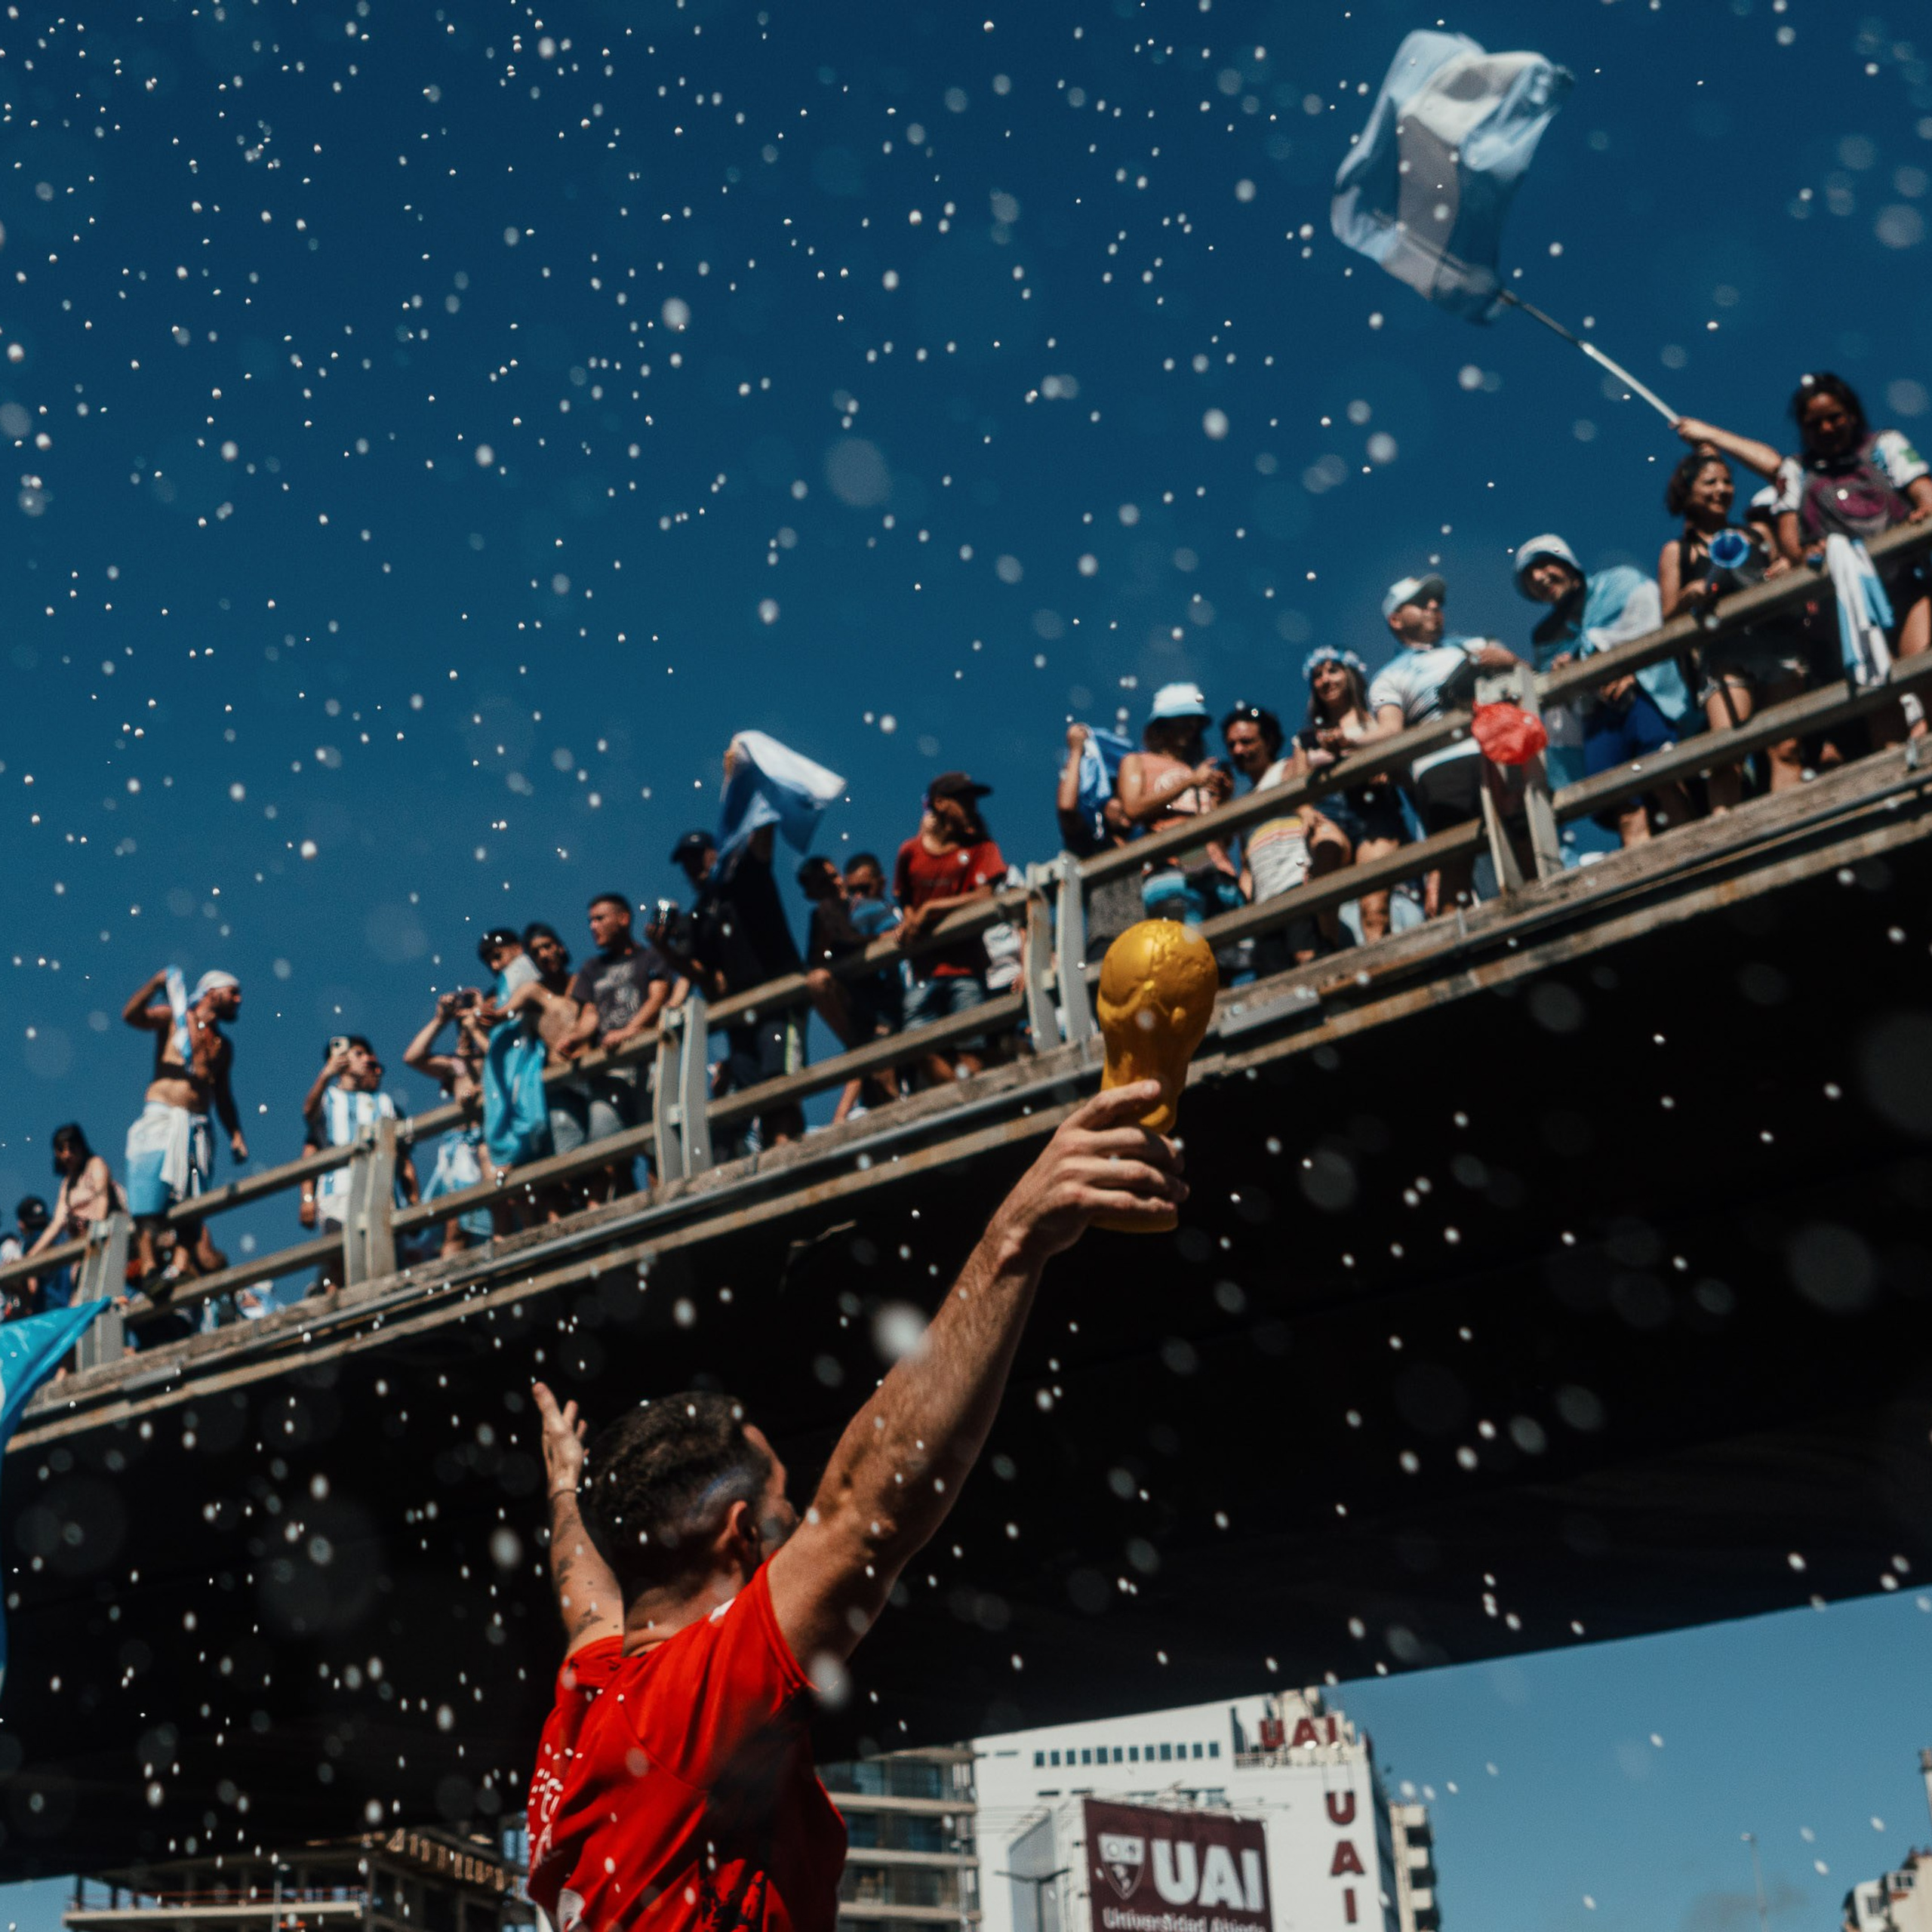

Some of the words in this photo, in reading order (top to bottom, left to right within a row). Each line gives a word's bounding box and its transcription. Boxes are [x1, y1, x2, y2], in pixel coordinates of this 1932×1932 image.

[1260, 1716, 1337, 1748] UAI
[1151, 1838, 1264, 1913] UAI
[1327, 1790, 1365, 1924] UAI
[1103, 1906, 1208, 1932] Universidad
